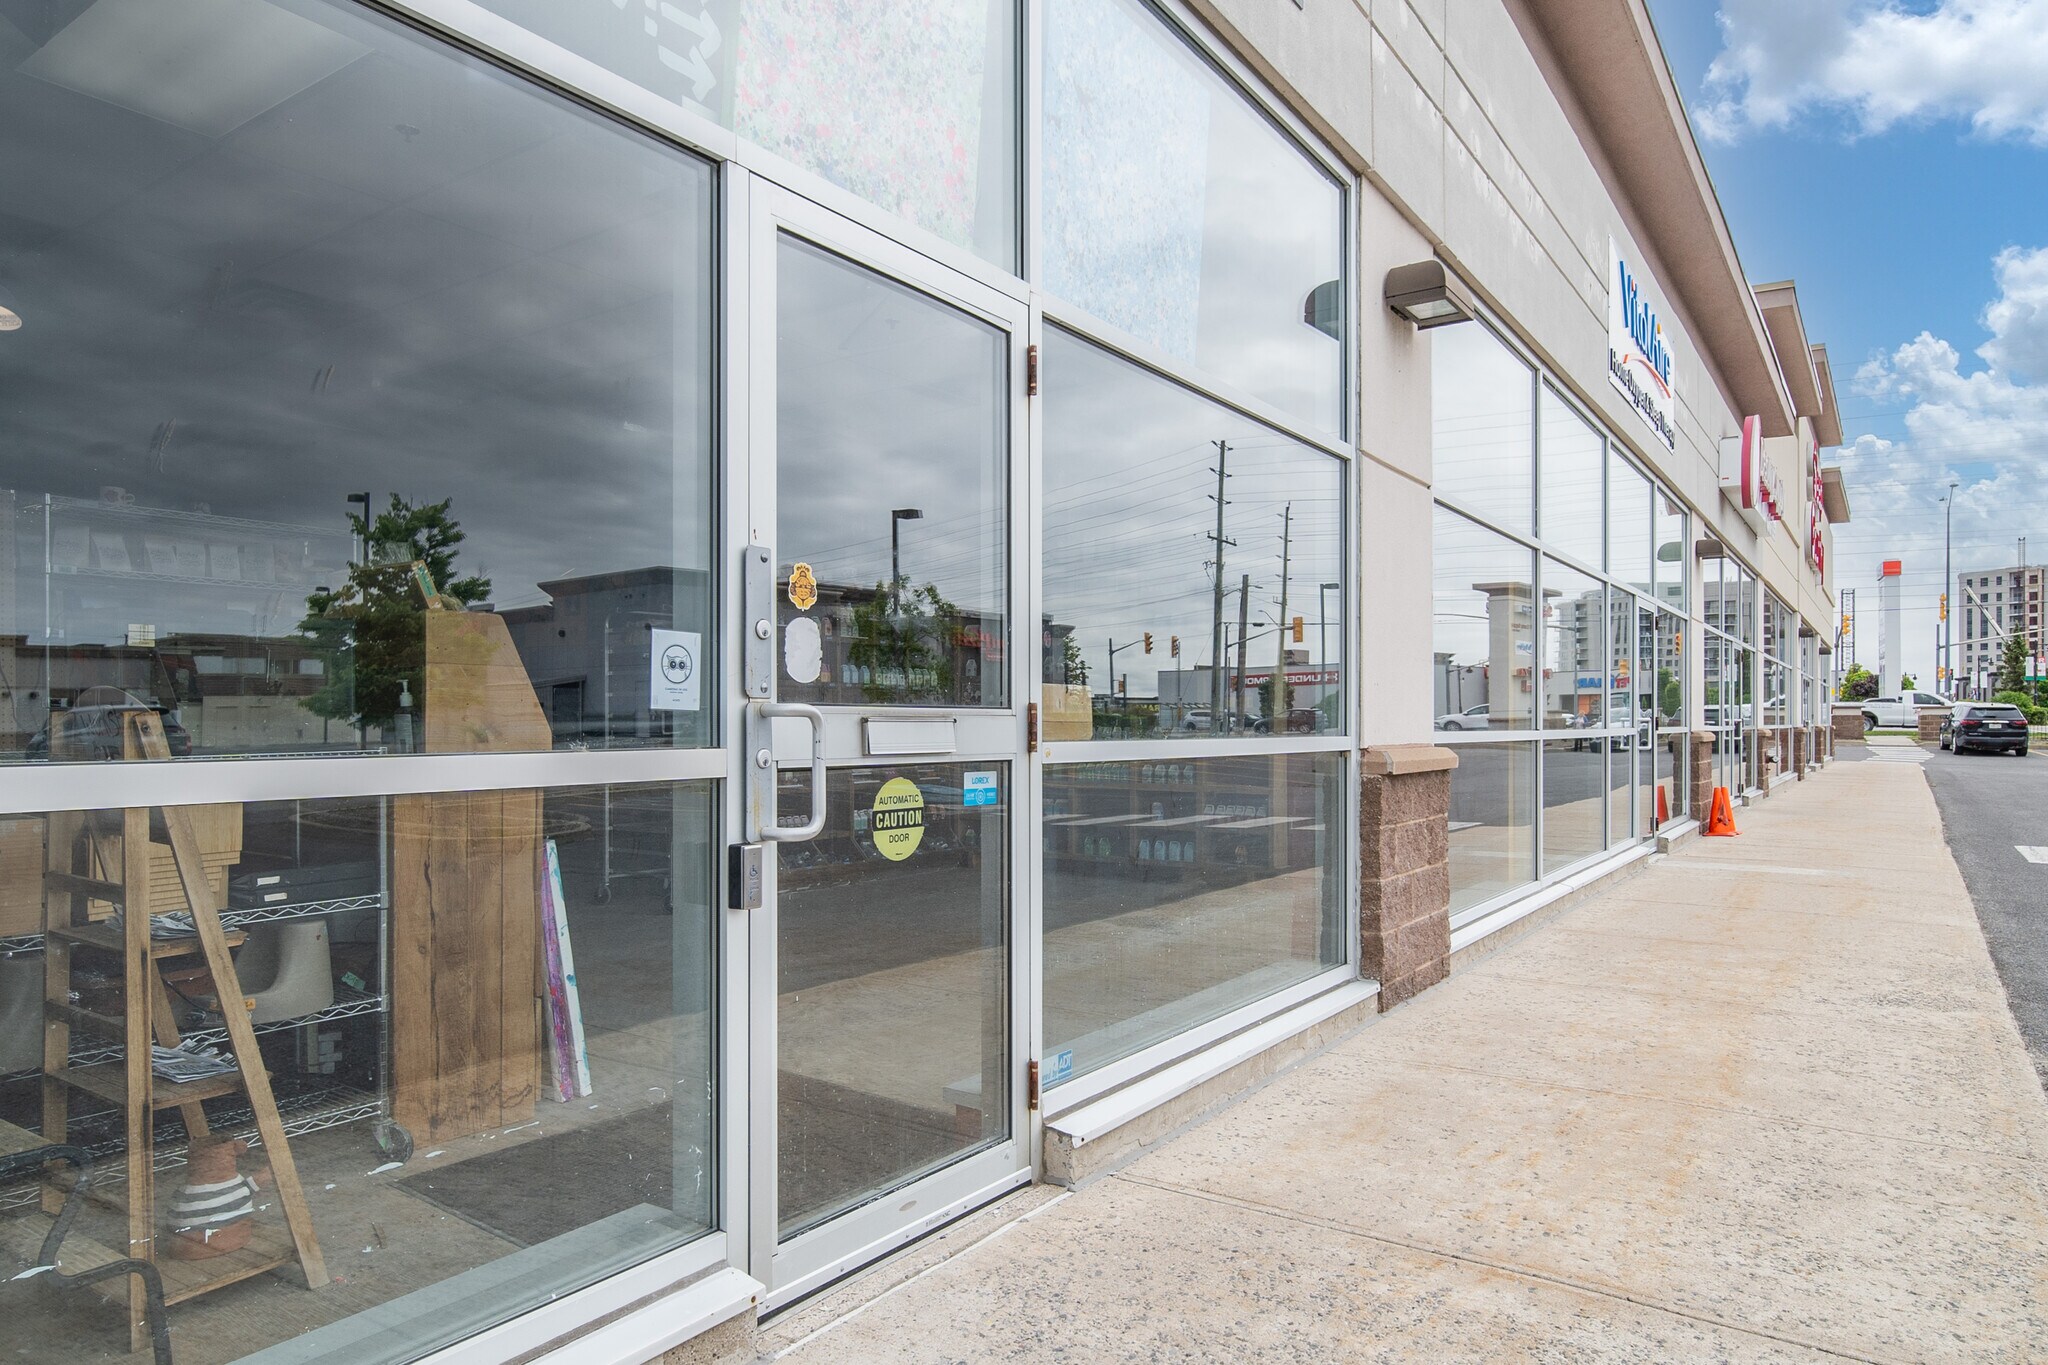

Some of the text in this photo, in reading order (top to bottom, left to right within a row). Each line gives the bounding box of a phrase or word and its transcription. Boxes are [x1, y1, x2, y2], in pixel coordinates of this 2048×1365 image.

[1619, 261, 1671, 386] VitalAire
[972, 776, 990, 785] LOREX
[879, 794, 920, 805] AUTOMATIC
[876, 810, 922, 829] CAUTION
[888, 832, 910, 844] DOOR
